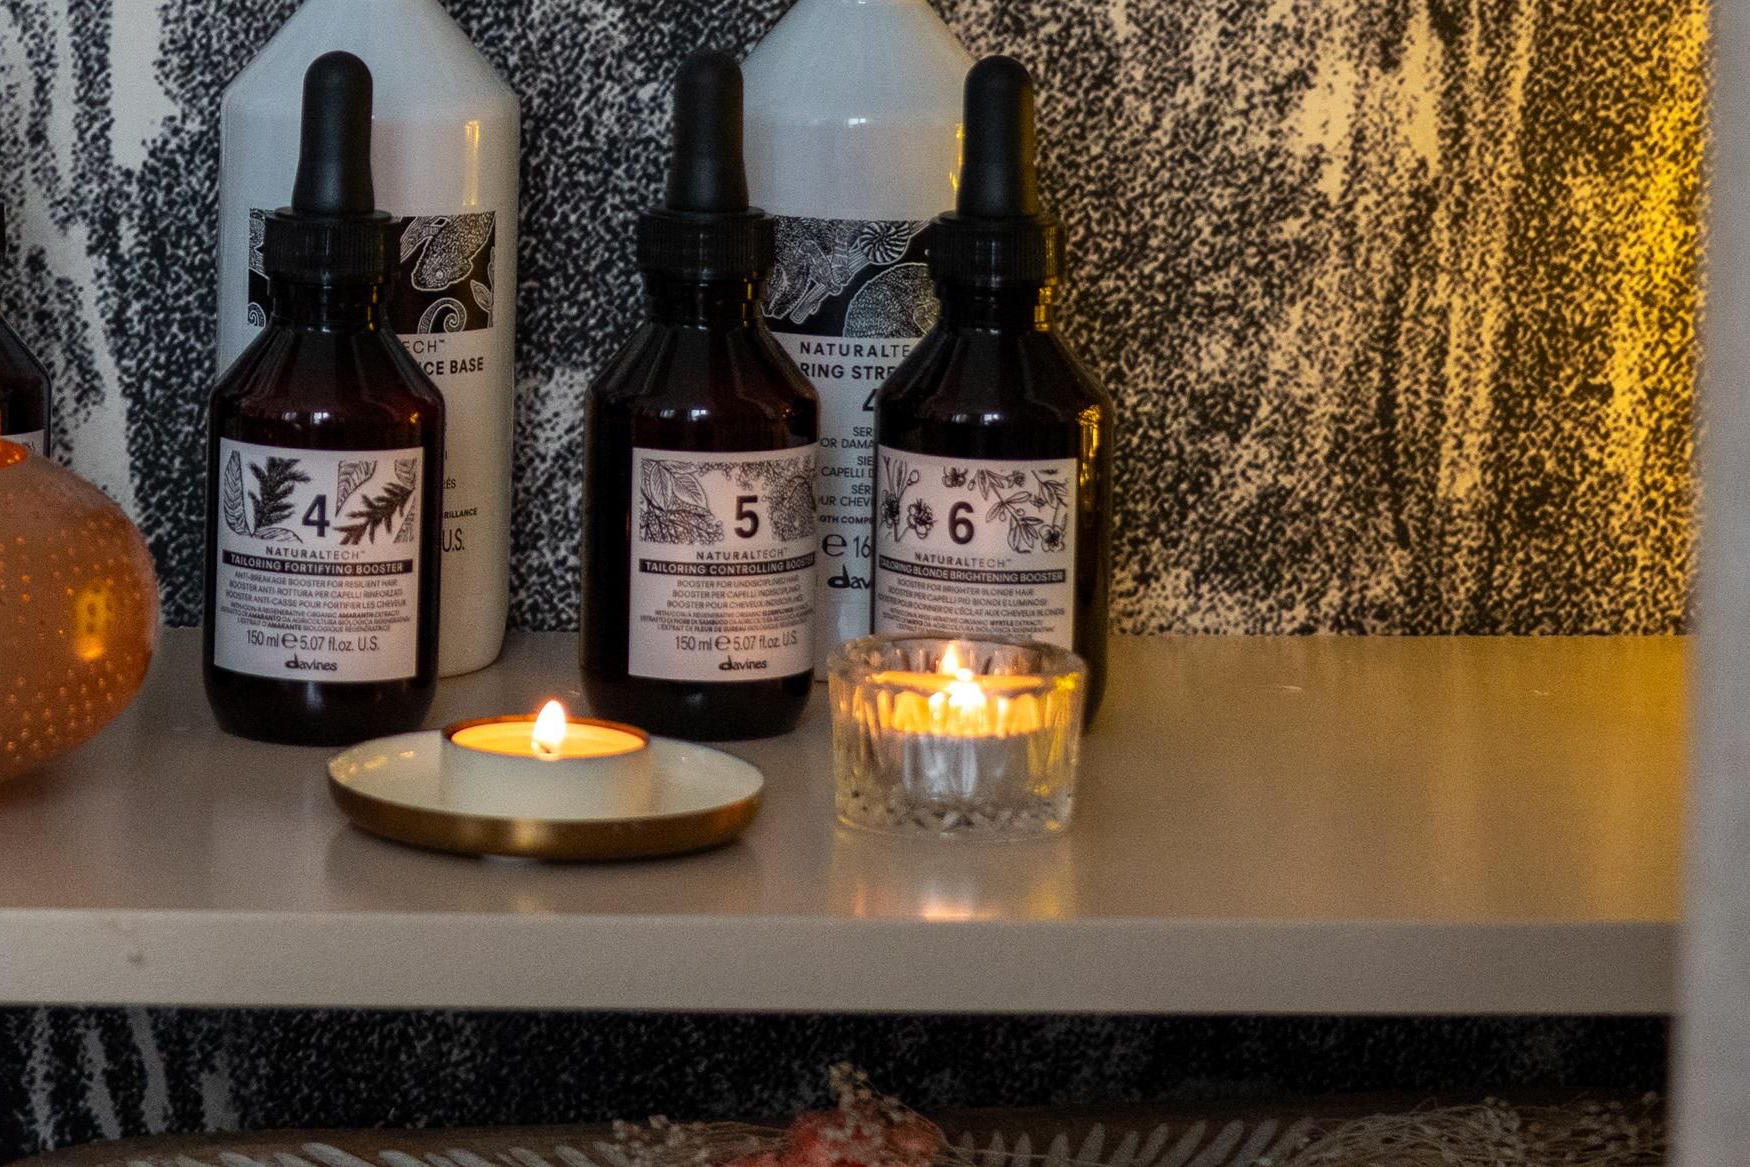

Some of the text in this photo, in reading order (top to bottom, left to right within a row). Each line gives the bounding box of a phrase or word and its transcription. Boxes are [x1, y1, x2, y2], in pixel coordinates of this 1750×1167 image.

[801, 342, 910, 358] NATURALTE
[450, 357, 483, 374] BASE
[853, 427, 873, 437] SER
[821, 438, 837, 448] OR
[857, 456, 873, 466] SIE
[822, 467, 863, 478] CAPELLI
[852, 483, 872, 494] SÉR
[302, 494, 330, 537] 4
[734, 495, 758, 538] 5
[949, 501, 974, 544] 6
[231, 554, 403, 574] TAILORING FORTIFYING BOOSTER
[645, 562, 705, 575] TAILORING
[710, 561, 783, 575] CONTROLLING
[913, 567, 948, 579] BLONDE
[950, 568, 1018, 582] BRIGHTENING
[1020, 570, 1064, 582] BOOSTER
[289, 578, 325, 587] BOOSTER
[327, 579, 343, 587] FOR
[677, 579, 715, 587] BOOSTER
[315, 589, 329, 597] PER
[672, 589, 710, 598] BOOSTER
[247, 630, 264, 645] 150
[266, 633, 279, 647] ml
[300, 636, 324, 649] 5.07
[358, 636, 380, 651] U.S.
[675, 635, 695, 650] 150
[699, 636, 712, 651] ml
[734, 636, 755, 650] 5.07
[285, 653, 337, 671] davines
[719, 656, 767, 671] davines
